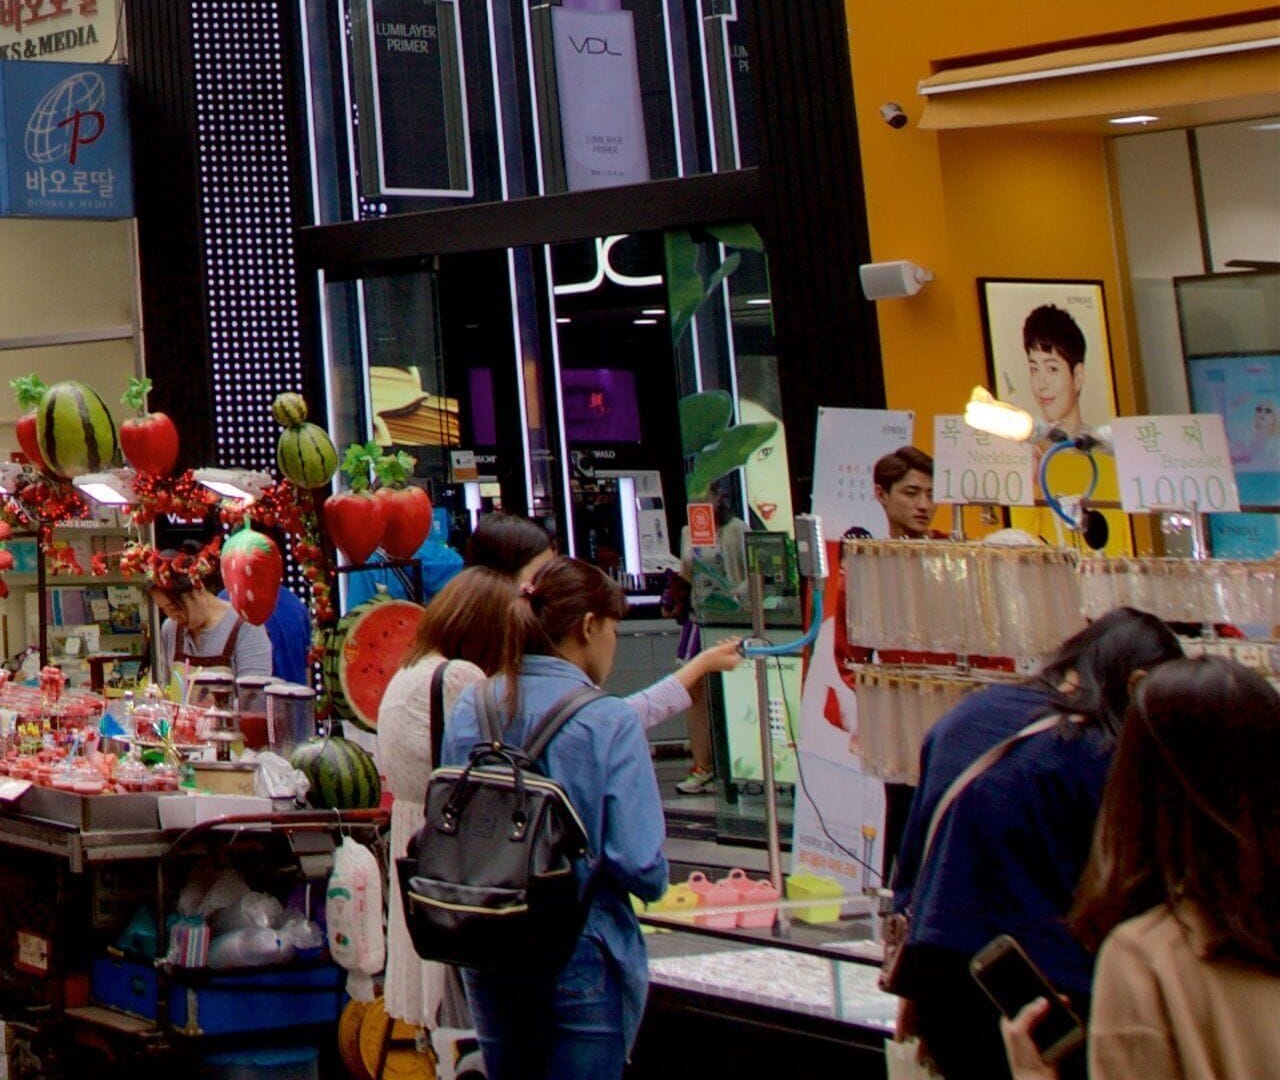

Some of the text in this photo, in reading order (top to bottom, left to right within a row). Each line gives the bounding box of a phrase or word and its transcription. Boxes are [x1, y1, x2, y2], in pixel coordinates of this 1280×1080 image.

[376, 21, 438, 39] LUMILAYER
[23, 38, 37, 60] &
[38, 22, 99, 57] MEDIA
[386, 38, 429, 55] PRIMER
[569, 35, 623, 56] VDL
[25, 166, 116, 198] 바오로딸
[968, 450, 1030, 466] Necklace
[1162, 454, 1225, 470] Bracelet
[942, 469, 1024, 503] 1000
[1130, 475, 1227, 511] 1000
